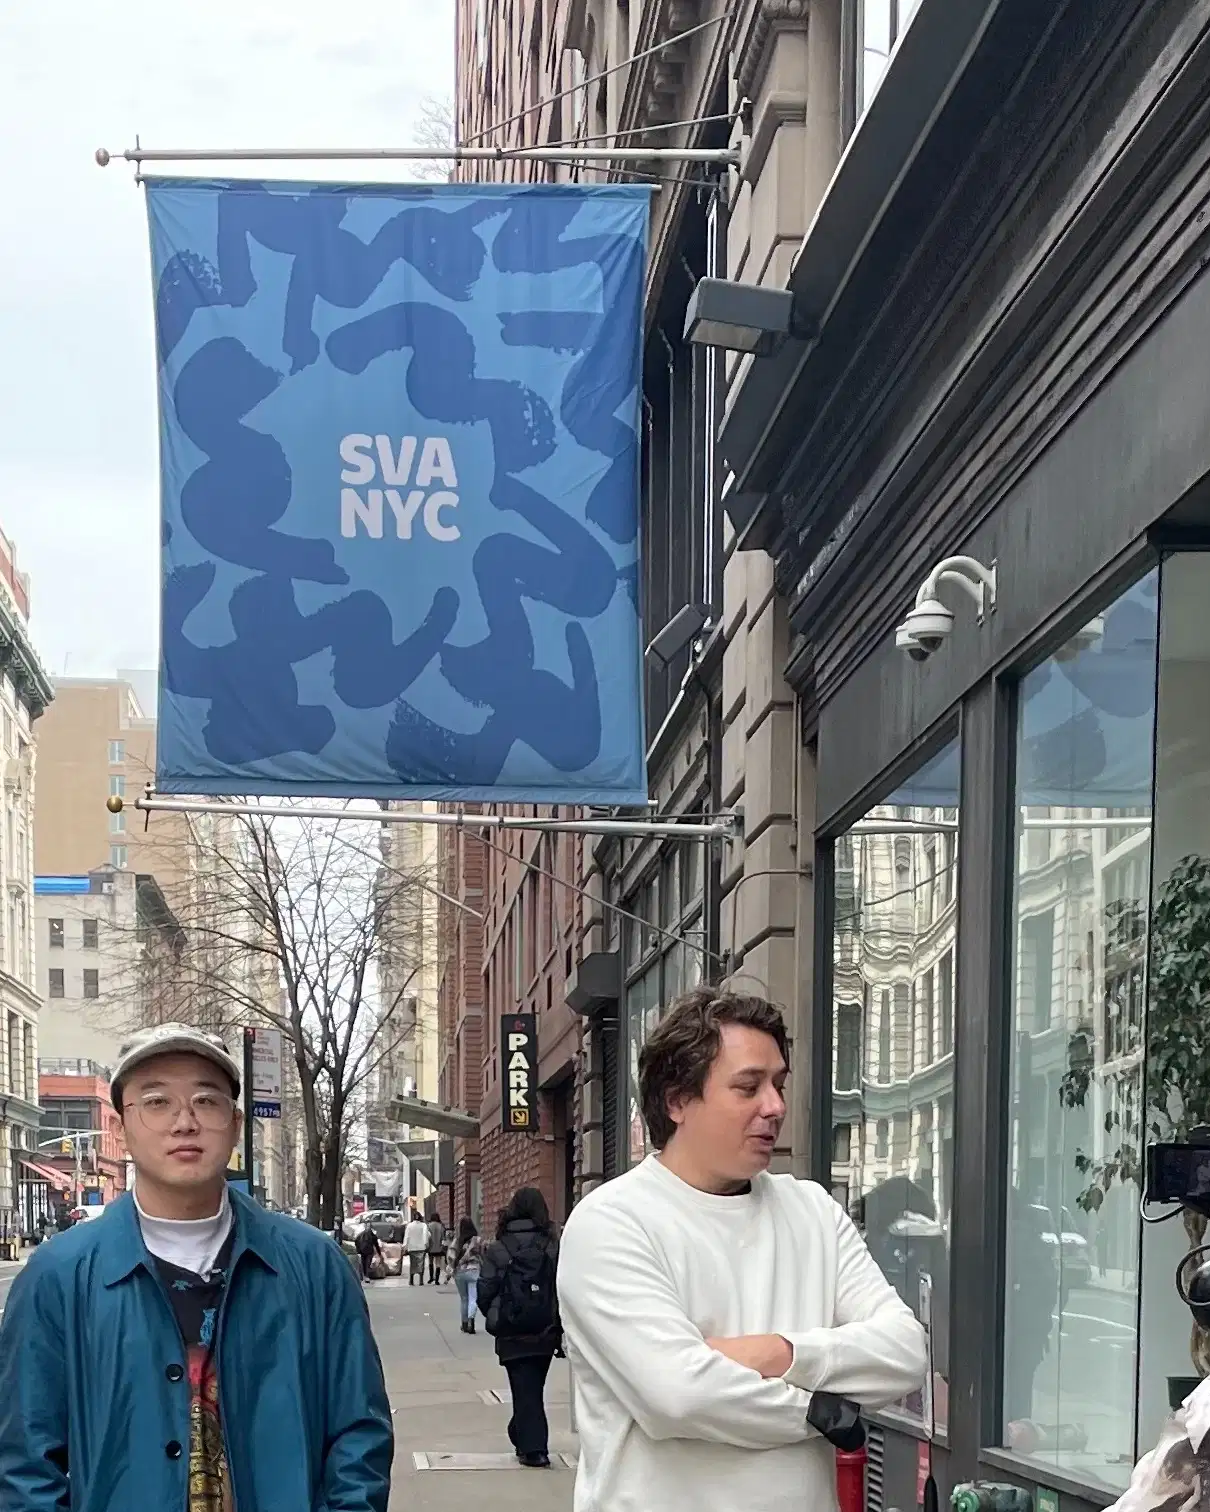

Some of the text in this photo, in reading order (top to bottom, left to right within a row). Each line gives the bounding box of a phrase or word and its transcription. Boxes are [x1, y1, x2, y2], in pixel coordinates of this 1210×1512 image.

[339, 433, 458, 488] SVA
[340, 487, 461, 542] NYC
[508, 1033, 530, 1107] PARK
